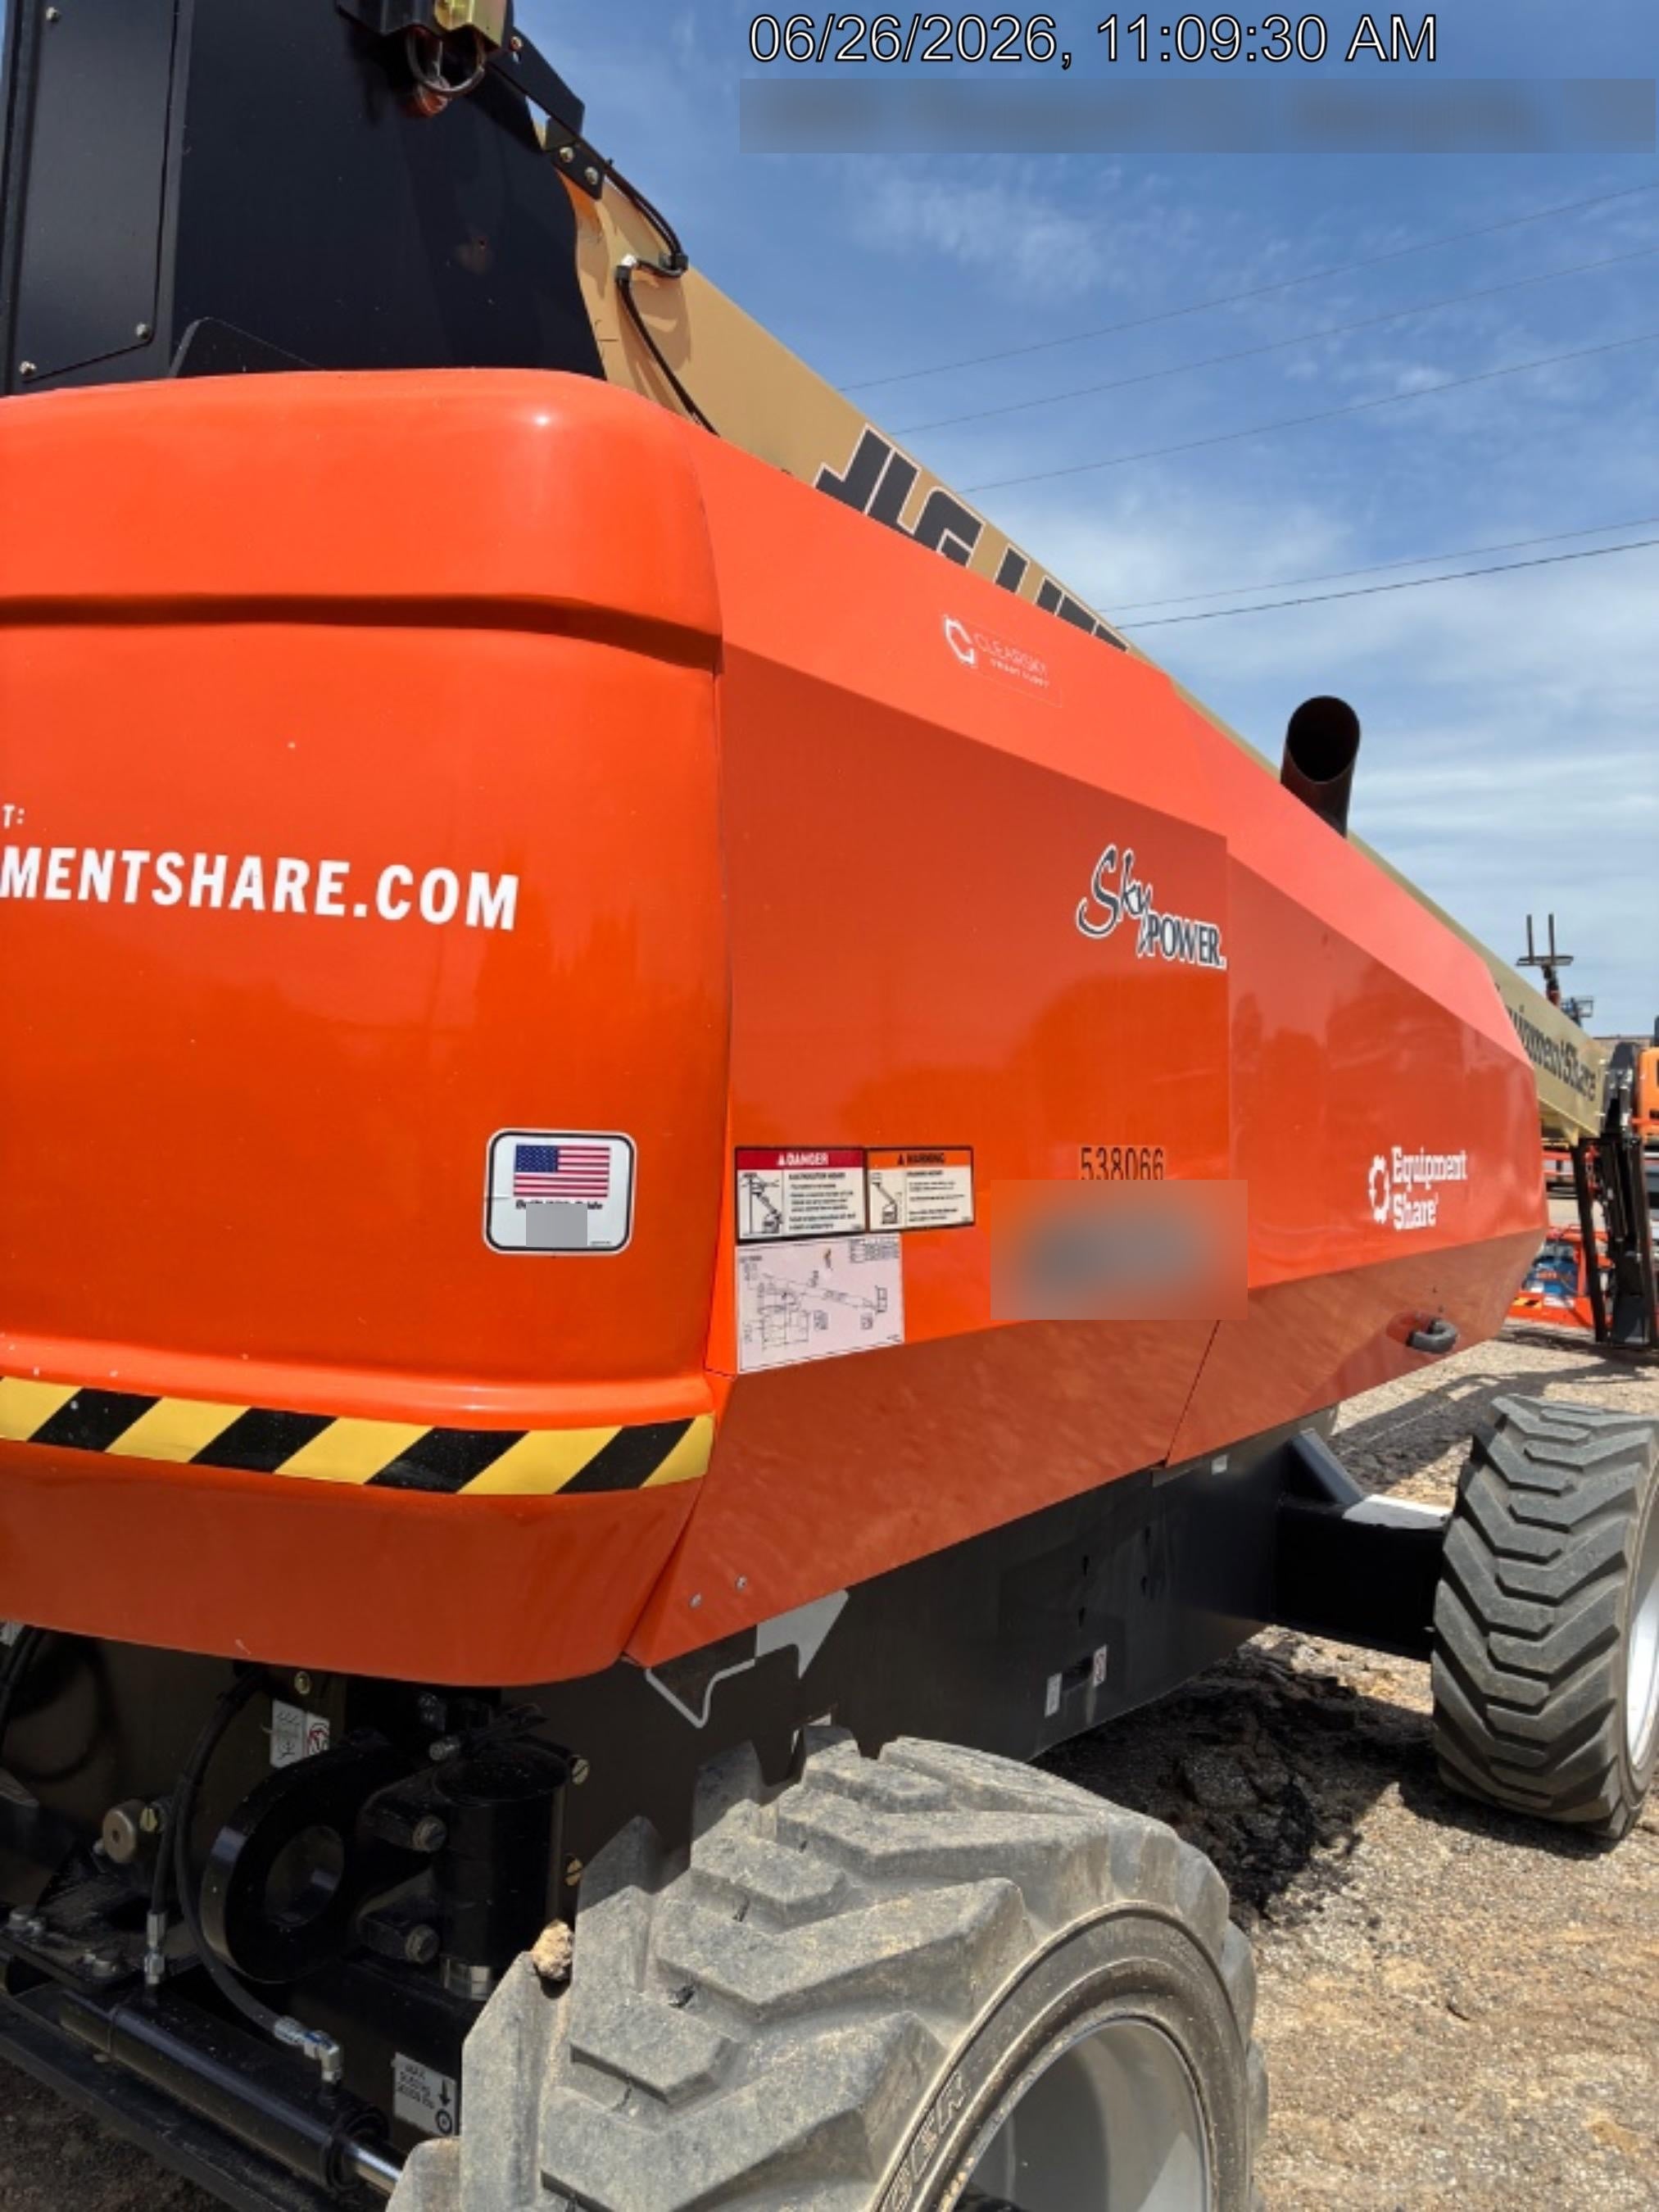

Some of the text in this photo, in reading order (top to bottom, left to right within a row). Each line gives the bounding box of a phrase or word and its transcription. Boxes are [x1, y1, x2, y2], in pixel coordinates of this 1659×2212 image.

[1, 845, 520, 931] MENTSHARE.COM
[1076, 844, 1153, 958] Sky
[786, 1152, 829, 1166] DANGER
[1081, 1147, 1163, 1180] 538066
[1391, 1145, 1467, 1192] Equipment
[1393, 1194, 1436, 1231] Share
